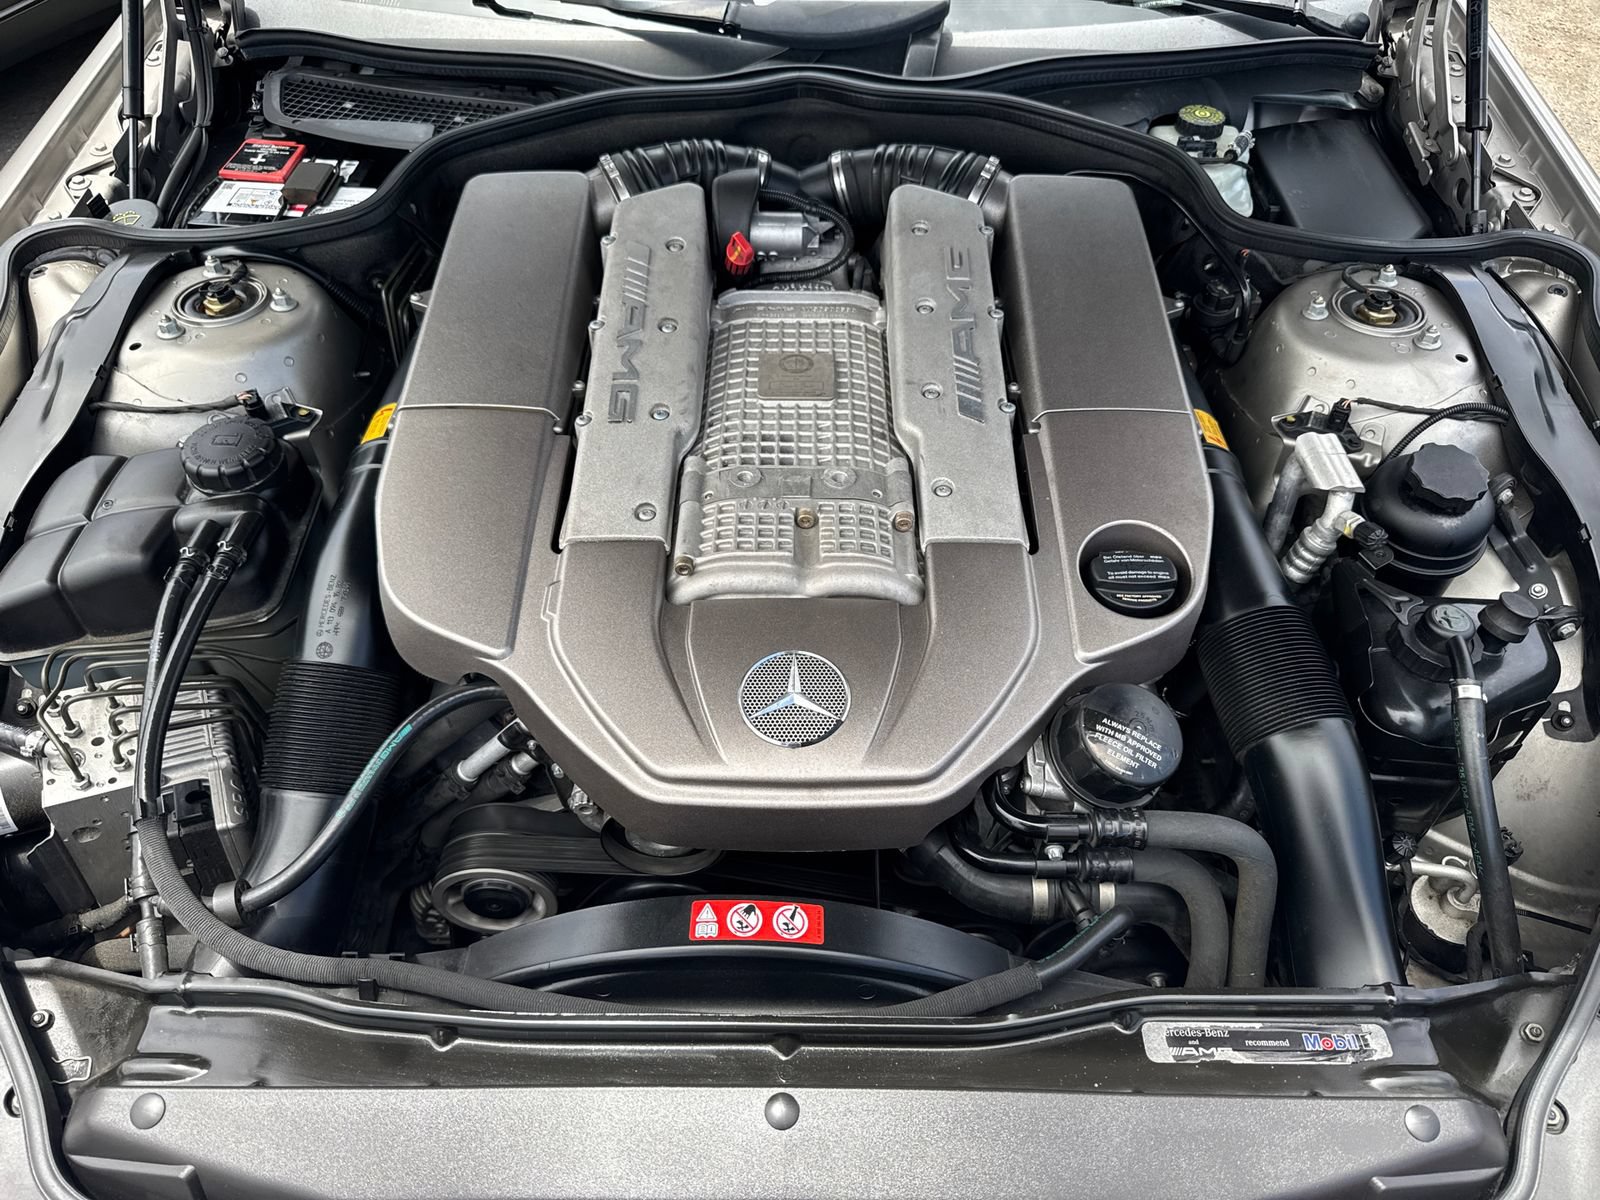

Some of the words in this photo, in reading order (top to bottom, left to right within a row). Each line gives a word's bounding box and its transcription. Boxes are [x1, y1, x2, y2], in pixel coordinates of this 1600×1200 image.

[608, 302, 647, 423] AMG
[1095, 724, 1114, 737] WITH
[1114, 732, 1127, 742] MB
[1126, 737, 1162, 761] APPROVED
[1095, 732, 1121, 749] FLEECE
[1122, 746, 1134, 757] OIL
[1135, 753, 1158, 769] FILTER
[1102, 717, 1131, 734] ALWAYS
[1131, 730, 1162, 751] REPLACE
[1107, 748, 1140, 769] ELEMENT
[1165, 1027, 1230, 1037] ercedes-Benz
[1245, 1038, 1290, 1047] recommend
[1302, 1033, 1360, 1051] Mobil
